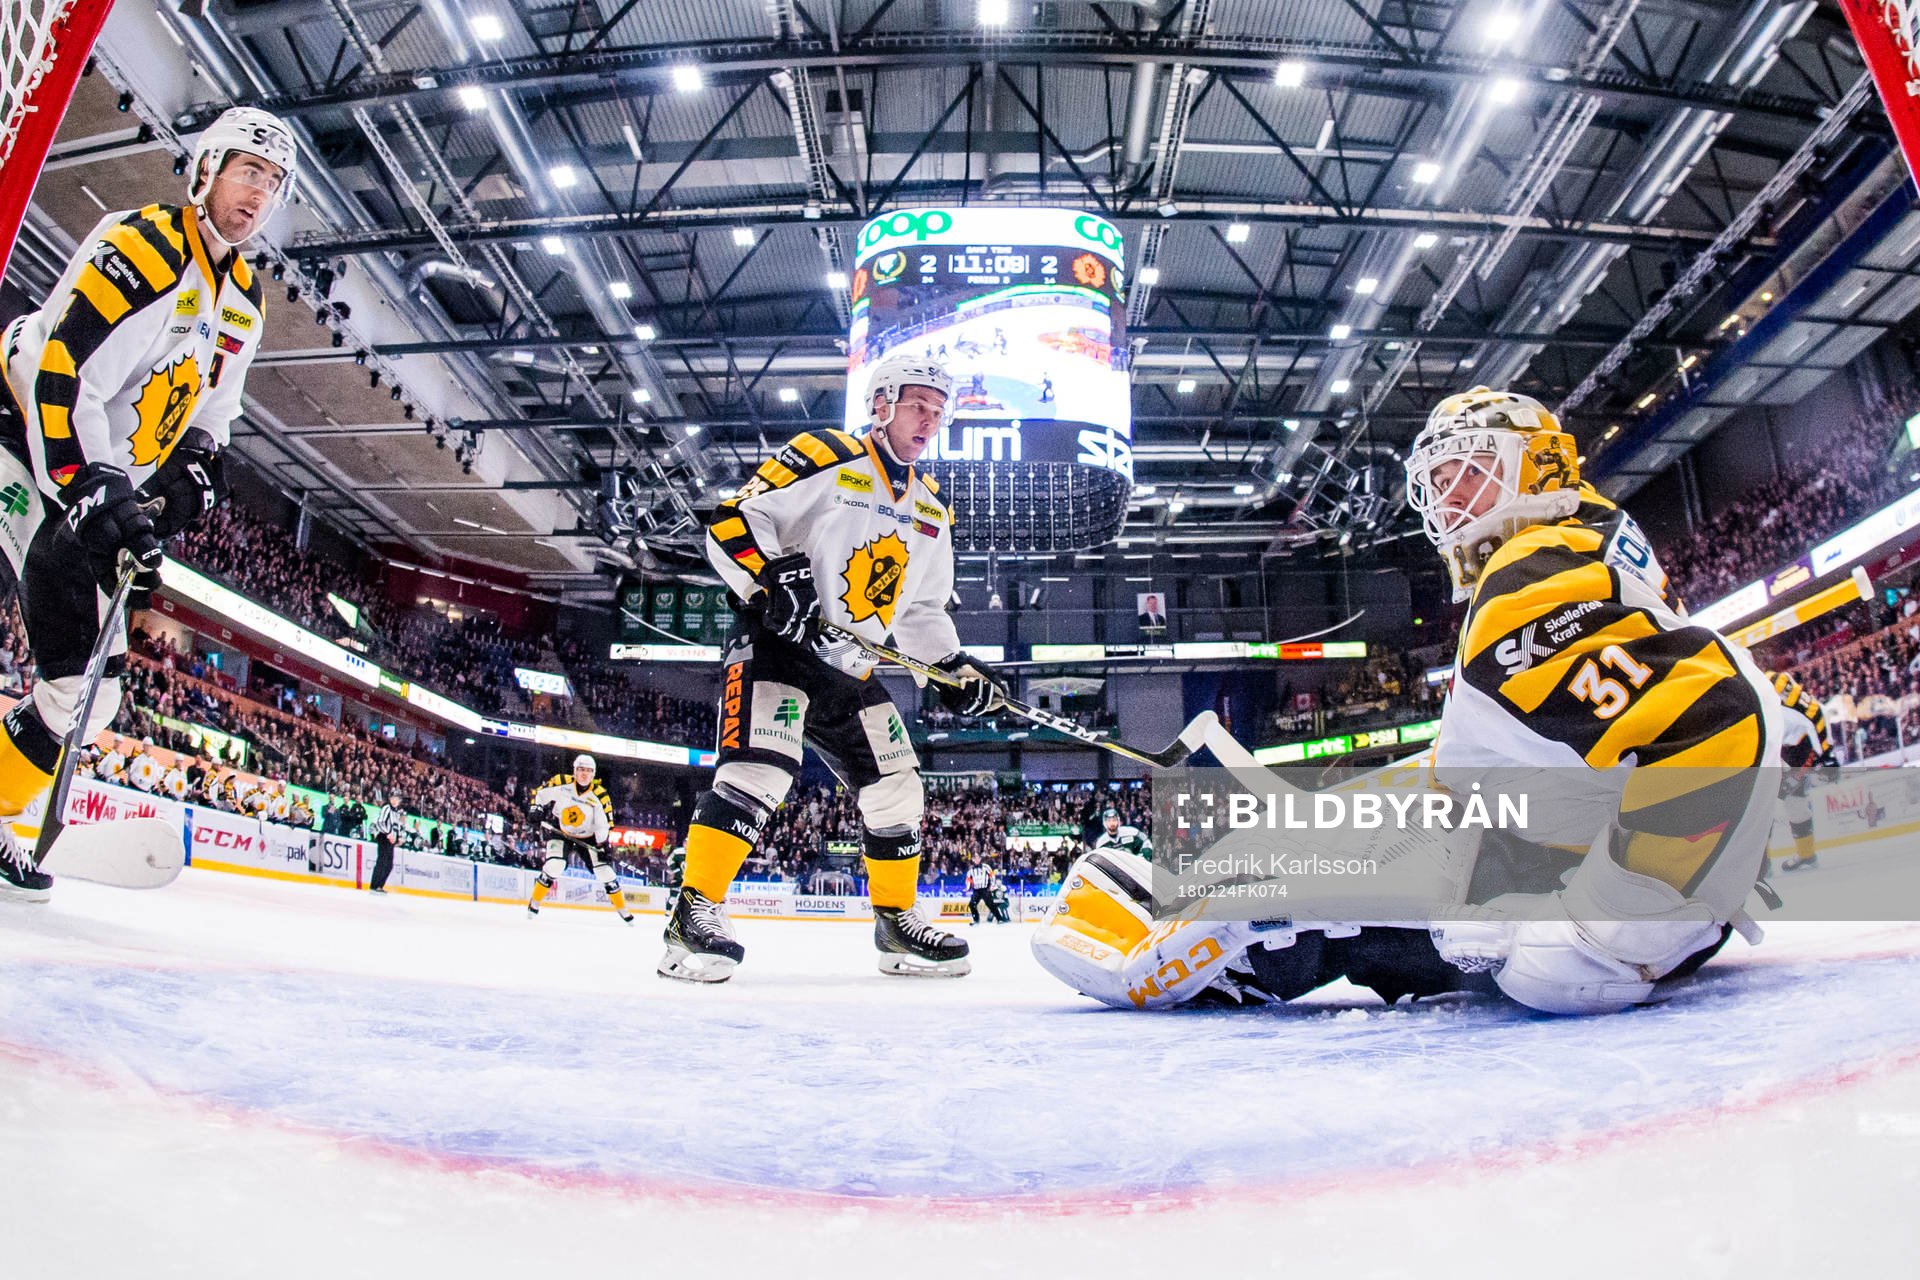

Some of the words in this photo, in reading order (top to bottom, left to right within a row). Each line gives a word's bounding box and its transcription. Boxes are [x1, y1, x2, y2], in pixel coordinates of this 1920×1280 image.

[919, 254, 937, 273] 2
[1041, 255, 1058, 274] 2
[778, 567, 811, 584] CC
[1551, 622, 1584, 644] Kraft
[1567, 644, 1654, 720] 31
[721, 662, 744, 749] REPAY
[1026, 707, 1099, 742] CCM
[194, 826, 253, 851] CCM
[323, 840, 352, 871] SST
[795, 898, 846, 909] HÖJDENS
[1127, 937, 1224, 1008] CCM
